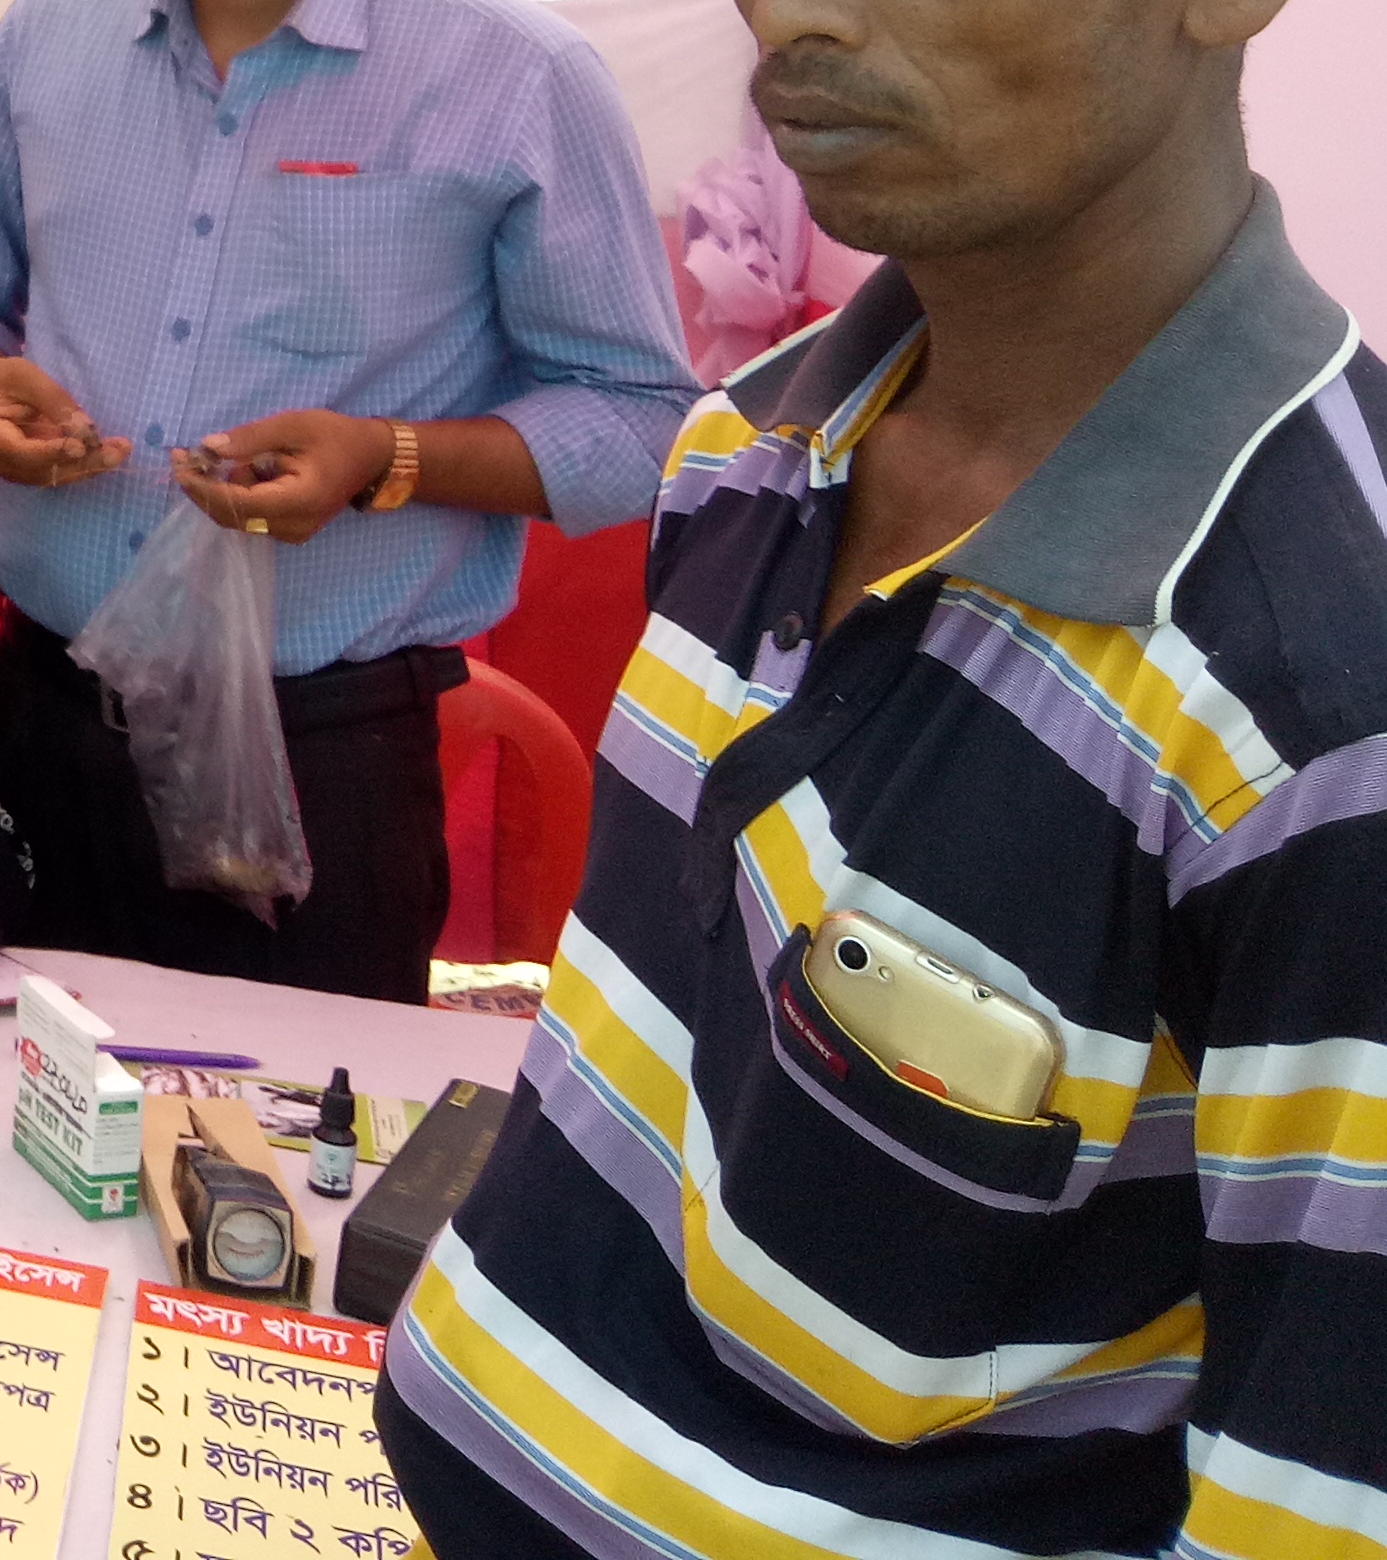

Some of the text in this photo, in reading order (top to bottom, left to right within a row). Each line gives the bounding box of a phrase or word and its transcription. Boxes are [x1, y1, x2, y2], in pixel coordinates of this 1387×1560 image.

[35, 1098, 59, 1135] TEST
[63, 1124, 83, 1156] KIT
[143, 1291, 251, 1337] মৎস্য
[260, 1316, 355, 1356] খাদ্য
[205, 1348, 377, 1402] আবেদনপ
[204, 1388, 348, 1450] ইউনিয়ন
[203, 1436, 334, 1499] ইউনিয়ন
[197, 1495, 274, 1540] ছবি
[289, 1516, 321, 1555] ২
